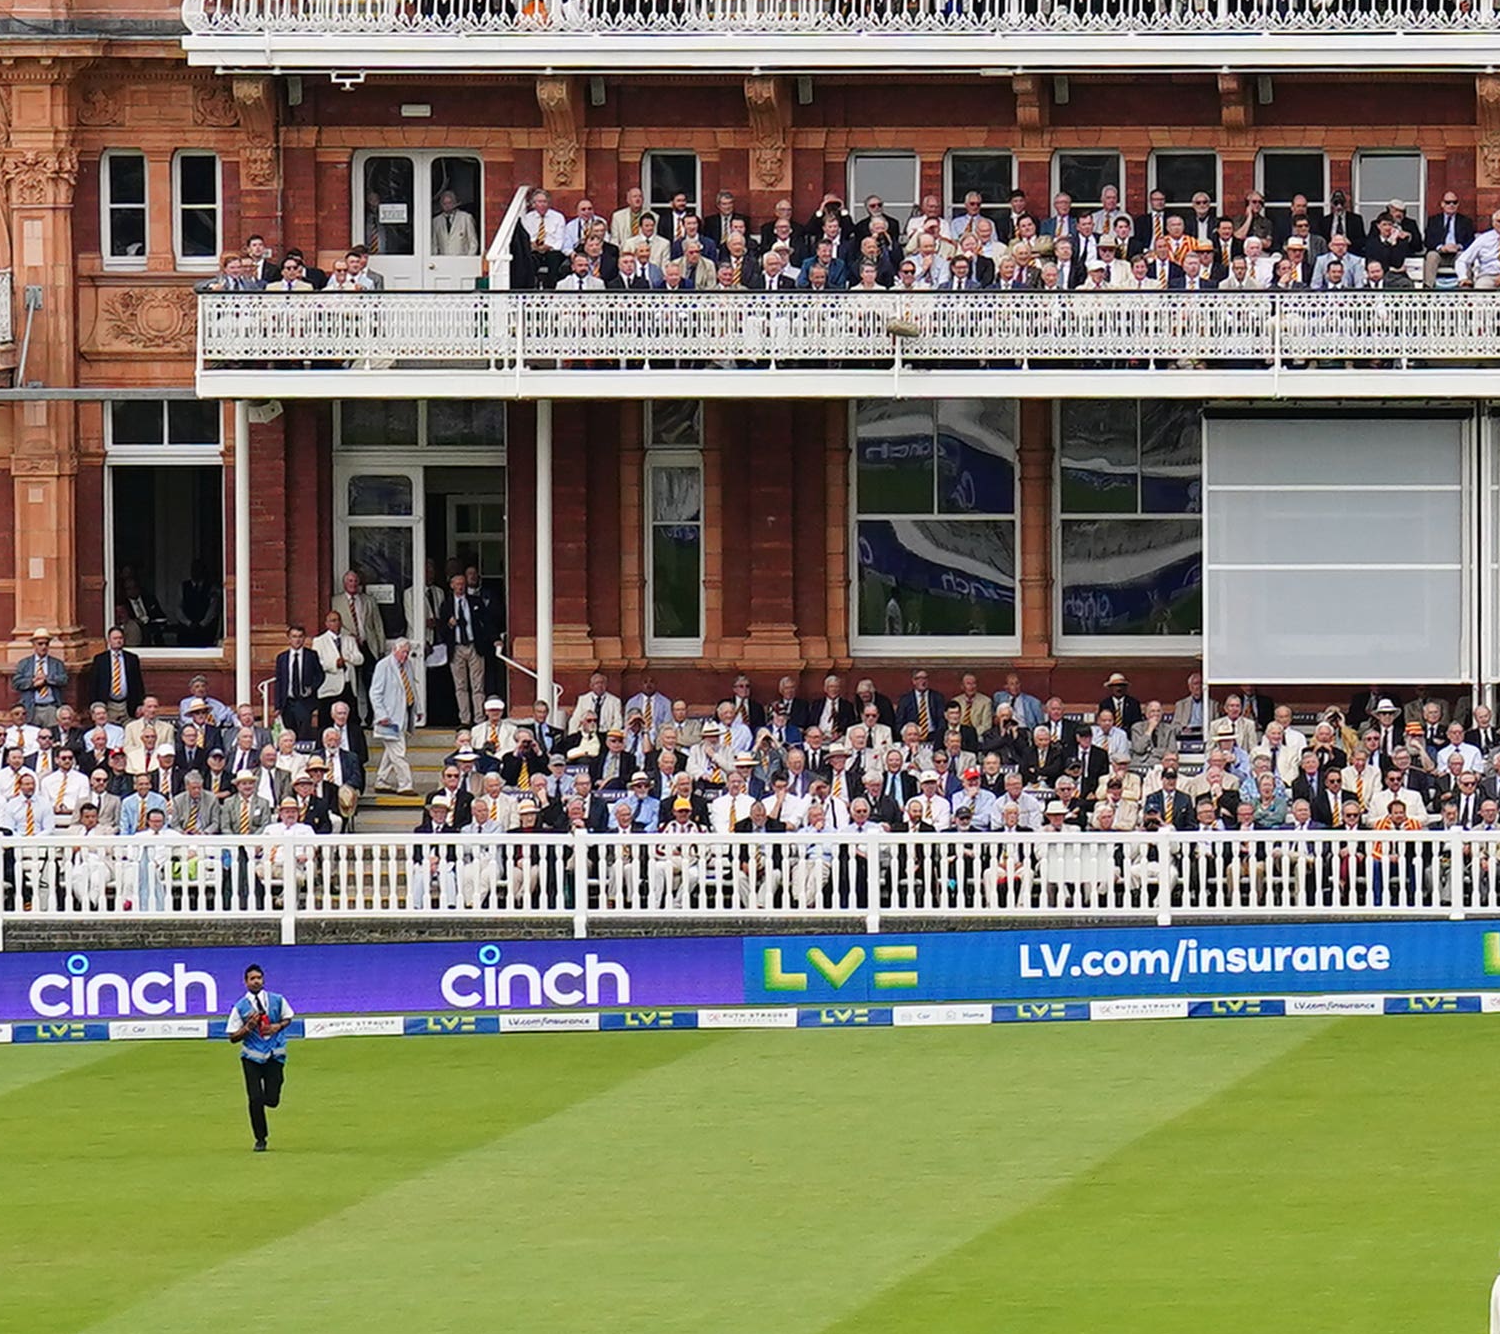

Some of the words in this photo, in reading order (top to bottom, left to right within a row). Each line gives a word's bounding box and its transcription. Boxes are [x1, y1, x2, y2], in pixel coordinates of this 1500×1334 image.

[30, 955, 217, 1017] cinch
[441, 945, 629, 1007] cinch
[1019, 938, 1391, 983] LV.com/insurance
